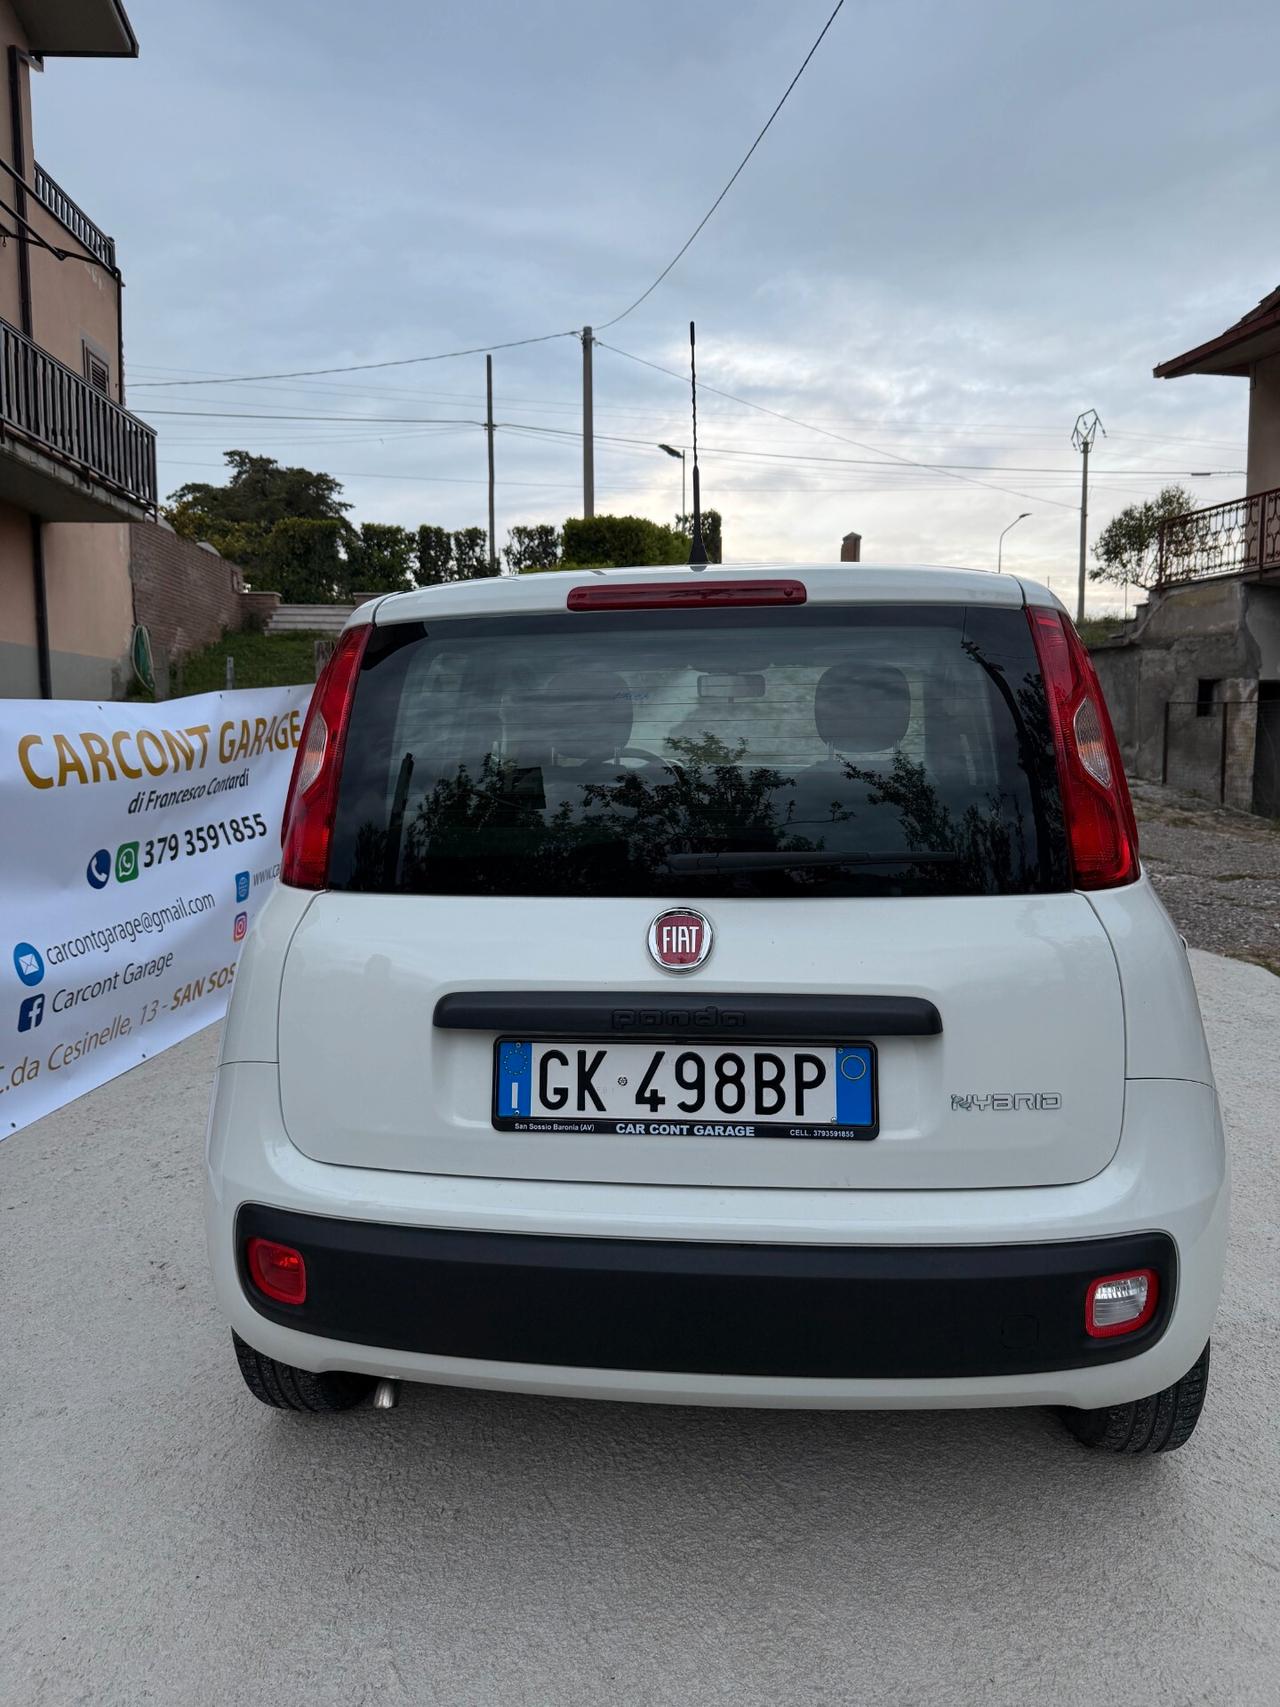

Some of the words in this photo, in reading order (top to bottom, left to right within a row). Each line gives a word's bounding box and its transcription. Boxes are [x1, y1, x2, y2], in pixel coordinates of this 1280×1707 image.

[18, 724, 211, 789] CARCONT
[218, 709, 302, 764] GARAGE
[128, 791, 145, 814] di
[145, 784, 206, 811] Francesco
[207, 768, 250, 795] Contardi
[144, 833, 179, 868] 379
[184, 813, 267, 856] 3591855
[46, 891, 216, 965] carcontgarage@gmail.com
[662, 926, 699, 953] FIAT
[52, 971, 119, 1013] Carcont
[123, 952, 174, 985] Garage
[48, 1014, 133, 1071] Cesinelle,
[140, 1000, 159, 1025] 13
[170, 976, 206, 1011] SAN
[539, 1049, 608, 1112] GK
[635, 1051, 827, 1116] 498BP
[514, 1122, 528, 1130] San
[529, 1122, 552, 1131] Sossio
[553, 1123, 579, 1131] Baronia
[580, 1123, 595, 1132] (AV)
[616, 1123, 645, 1134] CAR
[650, 1124, 690, 1135] CONT
[694, 1125, 755, 1137] GARAGE
[789, 1129, 812, 1137] CELL.
[813, 1129, 854, 1138] 3793591855
